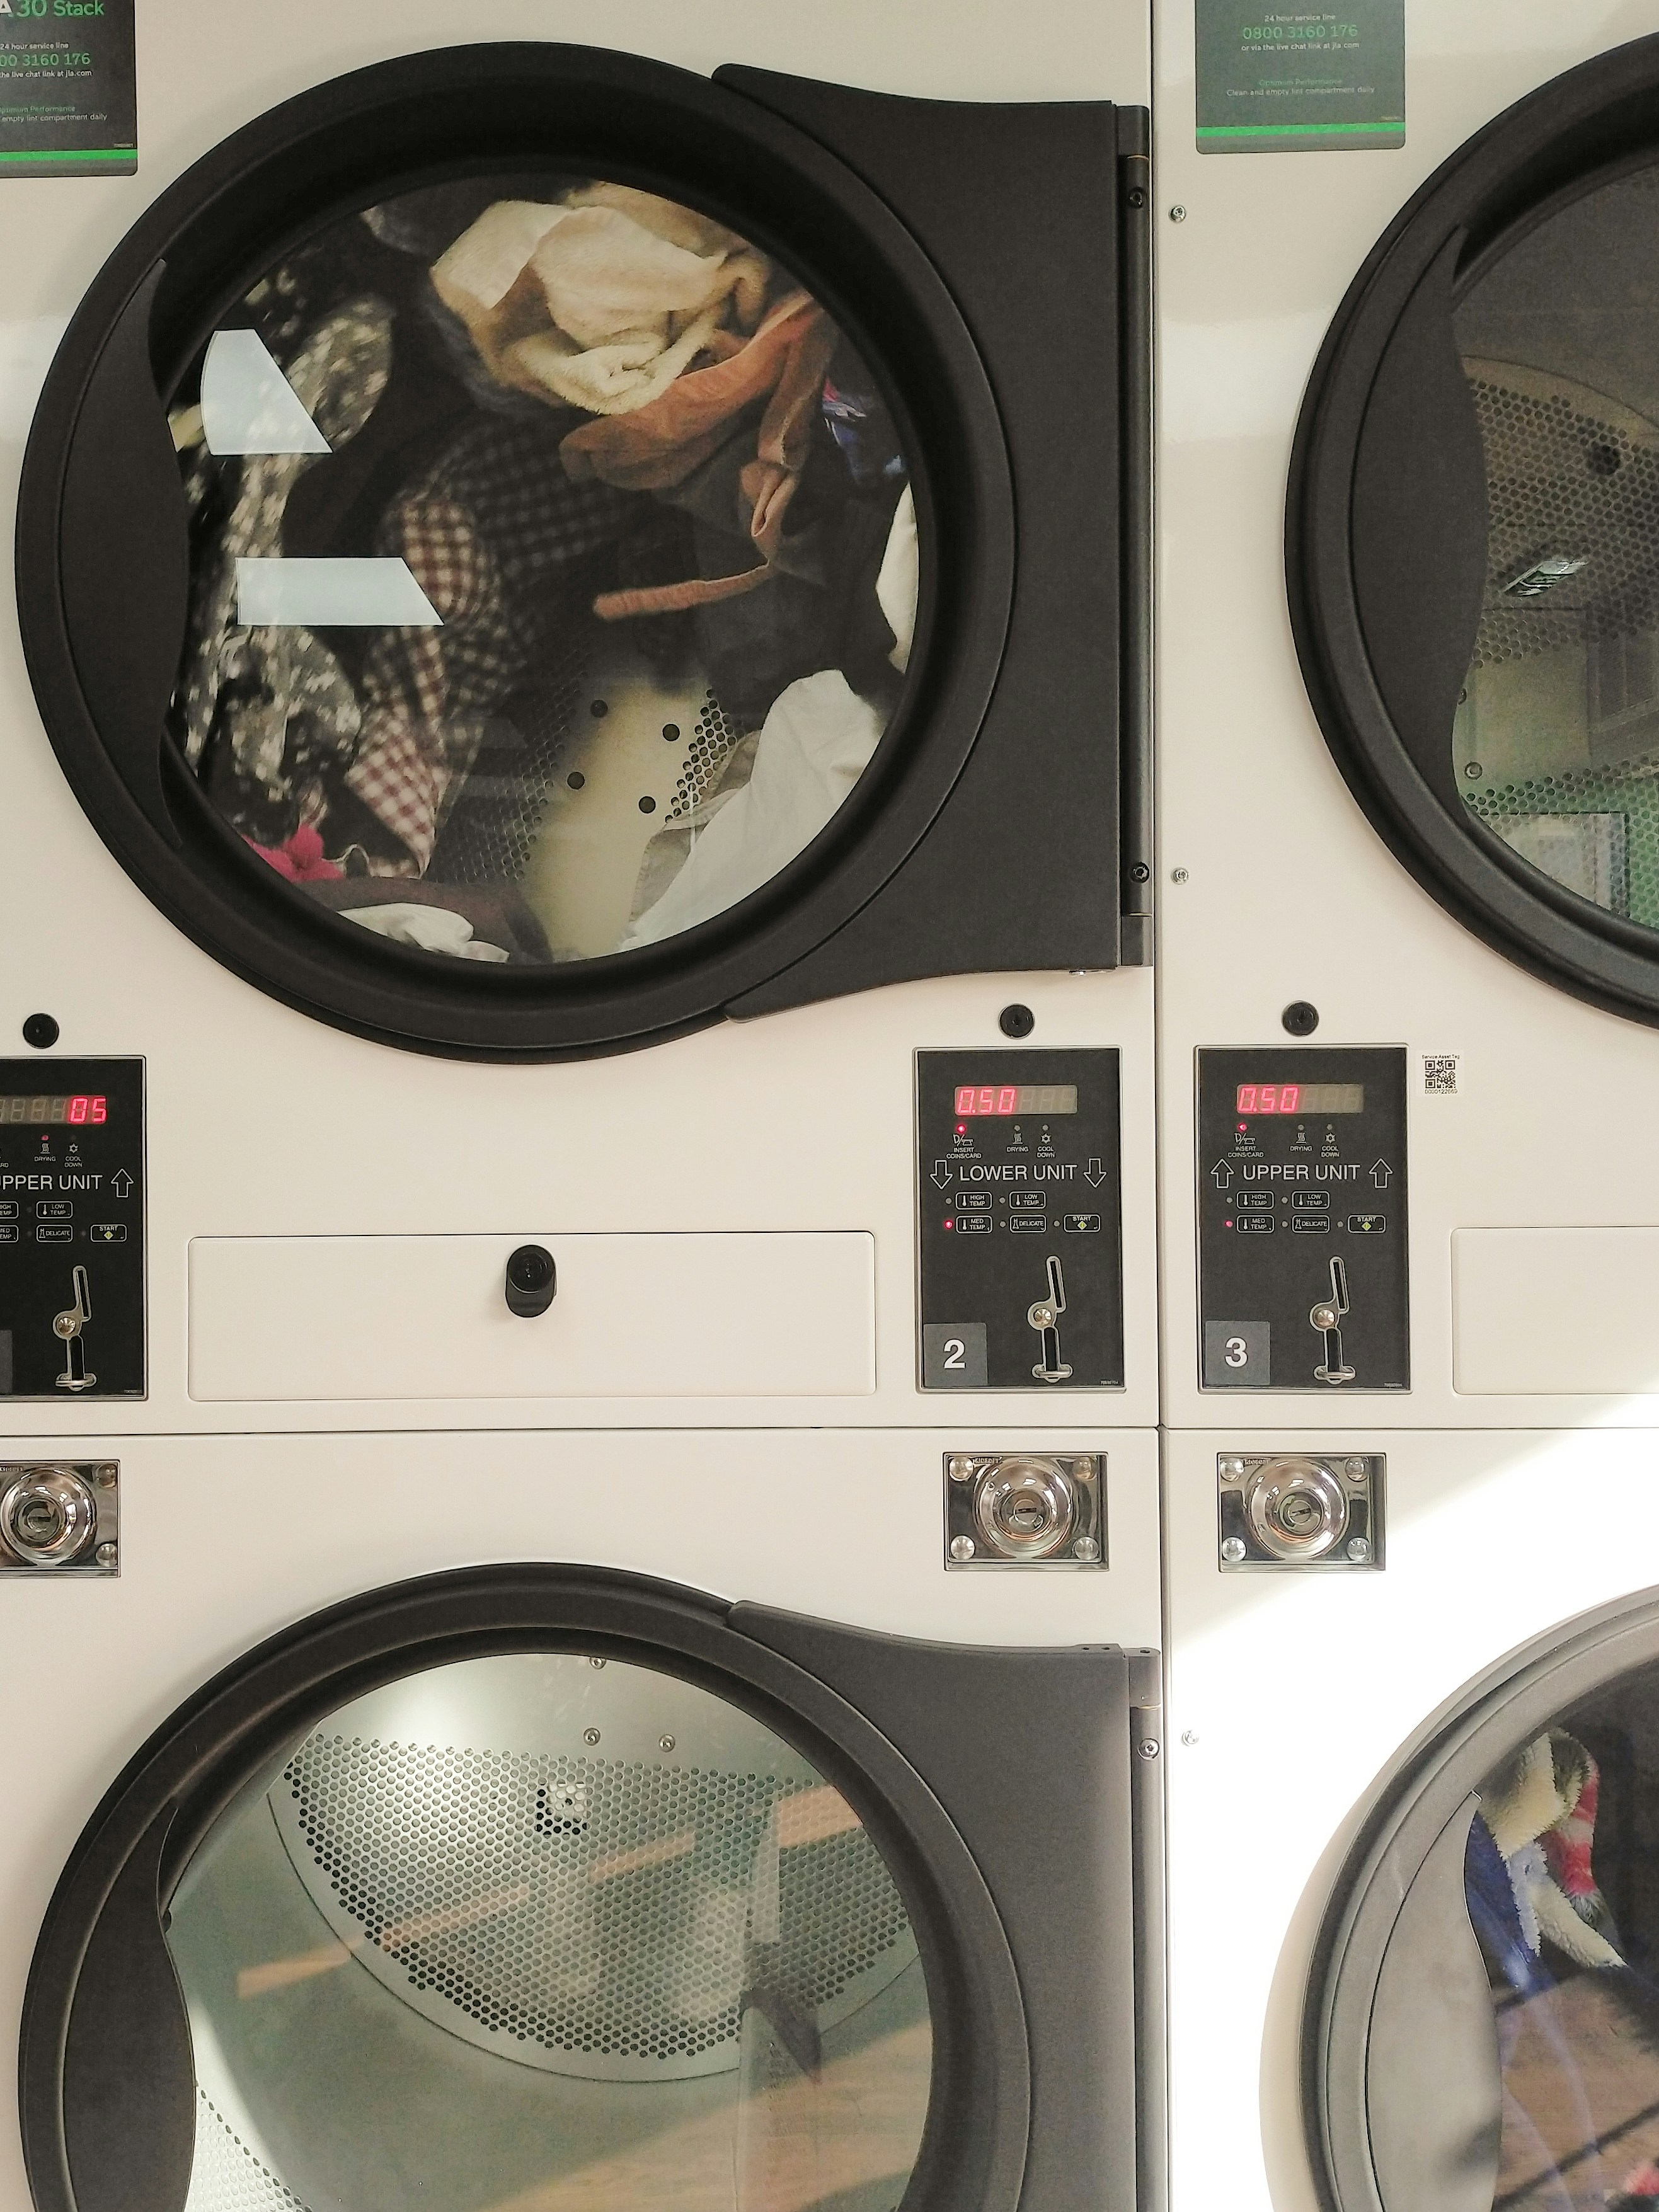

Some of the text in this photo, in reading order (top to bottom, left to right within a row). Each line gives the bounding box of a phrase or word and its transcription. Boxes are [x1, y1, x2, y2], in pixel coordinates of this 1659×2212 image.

[16, 0, 47, 18] 30
[53, 0, 105, 16] Stack
[1264, 14, 1275, 23] 24
[1243, 24, 1359, 40] 0800 3160 176
[11, 42, 27, 50] hour
[1331, 42, 1360, 50] jlacom
[22, 53, 59, 66] 3160
[64, 52, 91, 66] 176
[25, 69, 40, 77] chat
[65, 69, 93, 79] jla.com
[1226, 89, 1248, 97] Clean
[1266, 88, 1290, 96] empty
[1305, 87, 1355, 96] compartment
[1357, 85, 1375, 94] daily
[30, 105, 76, 113] Performance
[1, 115, 25, 123] empty
[40, 113, 88, 123] compartment
[89, 112, 108, 122] daily
[957, 1089, 1016, 1114] 0.50
[1239, 1087, 1298, 1112] 0.50
[70, 1097, 106, 1122] 05
[960, 1164, 1078, 1181] LOWER UNIT
[1243, 1165, 1361, 1180] UPPER UNIT
[0, 1174, 103, 1190] PPER UNIT
[943, 1339, 966, 1369] 2
[1225, 1336, 1248, 1368] 3
